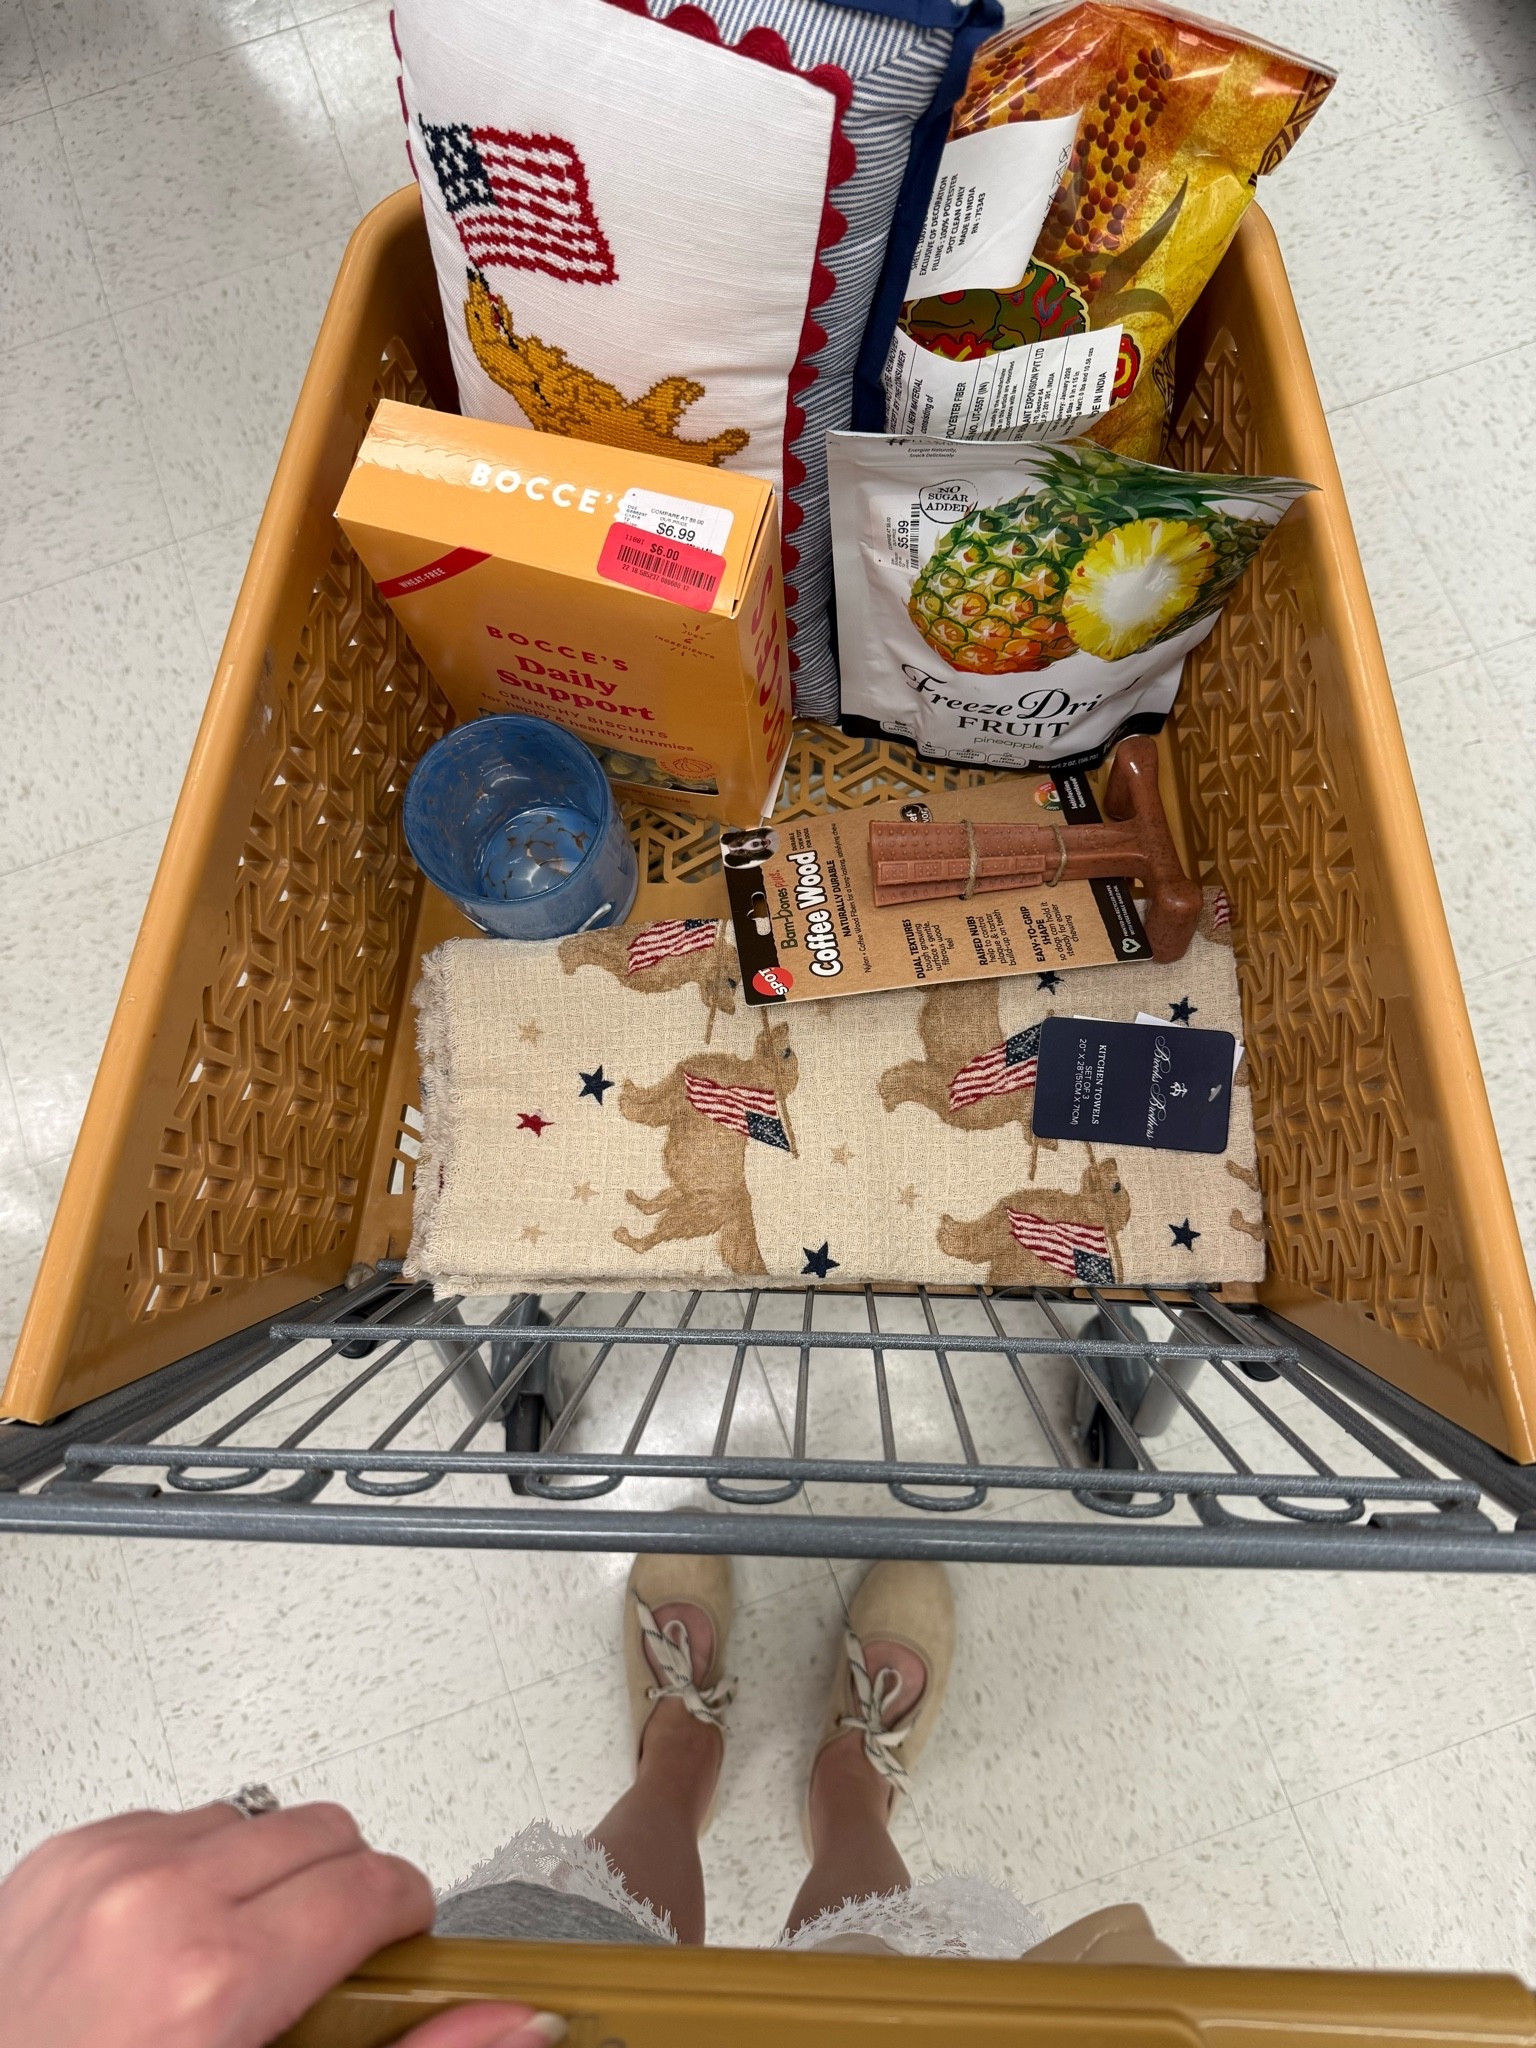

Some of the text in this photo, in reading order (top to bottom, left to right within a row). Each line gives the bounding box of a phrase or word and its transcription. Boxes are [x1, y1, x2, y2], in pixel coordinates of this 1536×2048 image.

[919, 176, 948, 276] EXCLUSIVE OF DECORATION
[932, 173, 959, 271] FILLING 100% POLYESTER
[946, 186, 965, 254] SPOT CLEAN ONLY
[958, 186, 976, 246] MADE IN INDIA
[971, 192, 986, 235] RN 75343
[886, 335, 899, 375] REMOVED
[895, 349, 907, 387] CONSUMER
[1025, 347, 1045, 409] EXPOVISION PVT LTD
[1047, 372, 1055, 389] INDIA
[1093, 371, 1108, 404] IN INDIA
[908, 379, 923, 423] NEW MATERIAL
[921, 394, 934, 434] consisting of
[945, 382, 966, 439] POLYESTER FIBER
[971, 396, 985, 423] UT-5557
[469, 462, 622, 521] BOCCE'
[928, 492, 969, 503] SUGAR
[938, 486, 961, 494] NO
[651, 508, 680, 520] COMPARE
[925, 502, 970, 513] ADDED
[656, 522, 696, 542] $6.99
[672, 519, 688, 527] PRICE
[897, 520, 909, 549] $5.99
[649, 543, 680, 561] $6.00
[398, 567, 446, 589] WHEAT-FREE
[639, 569, 659, 581] 585237
[486, 625, 629, 672] BOCCE'S
[654, 634, 716, 660] INGREDIENTS
[681, 630, 707, 641] JUST
[514, 655, 618, 696] Daily
[496, 669, 656, 721] Support
[901, 663, 1013, 717] Freeze
[481, 692, 694, 751] for happy & healthy tummies
[498, 690, 668, 739] CRUNCHY BISCUITS
[956, 715, 1070, 739] FRUIT
[888, 727, 913, 735] NATURAL
[974, 735, 1044, 750] pineapple
[1063, 780, 1078, 809] Satisfaction
[788, 832, 797, 851] DURABLE
[803, 828, 811, 840] DOGS
[831, 823, 840, 835] chew
[834, 836, 844, 859] satisfying
[826, 859, 852, 938] NATURALLY DURABLE
[847, 894, 855, 903] for
[786, 850, 843, 978] Coffee Wood
[854, 919, 862, 934] Wood
[986, 913, 997, 933] tartar
[1042, 908, 1053, 923] hold
[965, 915, 989, 966] RAISED NUBS
[976, 916, 997, 964] help to control
[992, 909, 1017, 967] build-up on teeth
[1020, 906, 1046, 963] EASY-TO-GRIP
[1035, 919, 1052, 946] SHAPE
[1049, 923, 1058, 936] can
[1051, 903, 1075, 957] steady for easier
[1065, 914, 1079, 942] chewing
[1120, 920, 1128, 936] PRINTED
[858, 934, 867, 951] Coffee
[902, 919, 926, 979] DUAL TEXTURES
[915, 923, 934, 972] tough gnawing
[931, 924, 951, 966] fibrous wood
[944, 938, 955, 950] feel
[994, 940, 1008, 964] plaque
[1054, 937, 1063, 953] dogs
[864, 957, 872, 973] Nylon
[930, 948, 943, 972] surface
[758, 968, 788, 996] SPOT
[1079, 1038, 1088, 1052] 20"
[1084, 1065, 1093, 1080] SET
[1092, 1044, 1107, 1125] KITCHEN TOWELS
[1084, 1082, 1091, 1092] OF
[1146, 1035, 1171, 1141] Brooks Brothers
[1069, 1104, 1081, 1126] 71CM)
